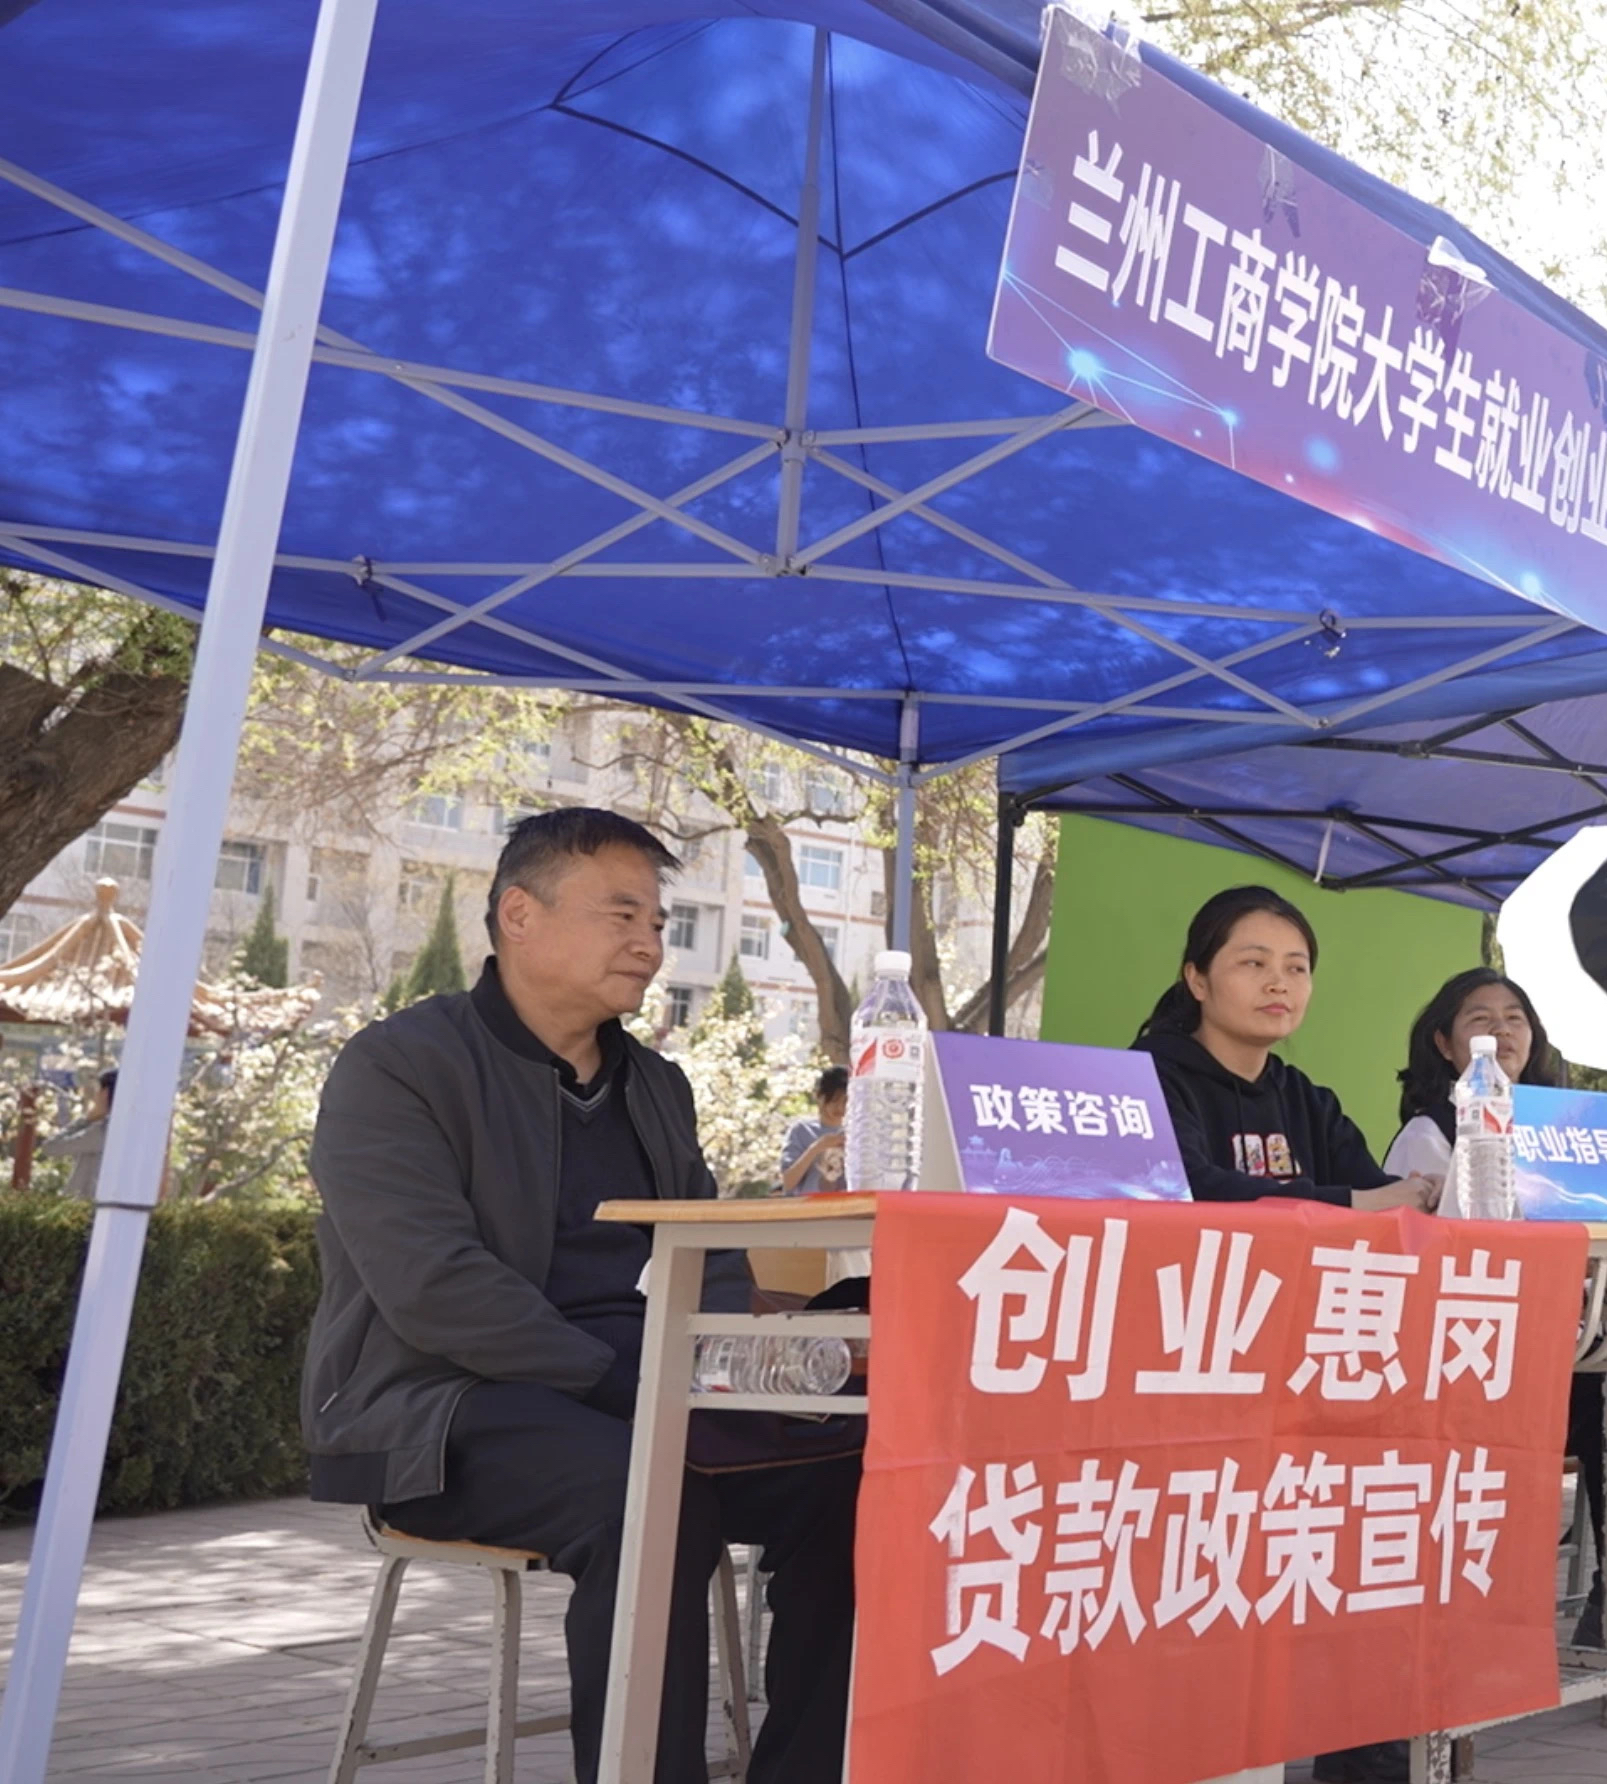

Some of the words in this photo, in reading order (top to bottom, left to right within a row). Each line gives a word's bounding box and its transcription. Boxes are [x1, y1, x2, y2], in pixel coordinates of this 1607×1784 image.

[969, 1083, 1155, 1141] 政策咨询
[956, 1205, 1523, 1402] 创业惠岗
[928, 1446, 1507, 1677] 贷款政策宣传
